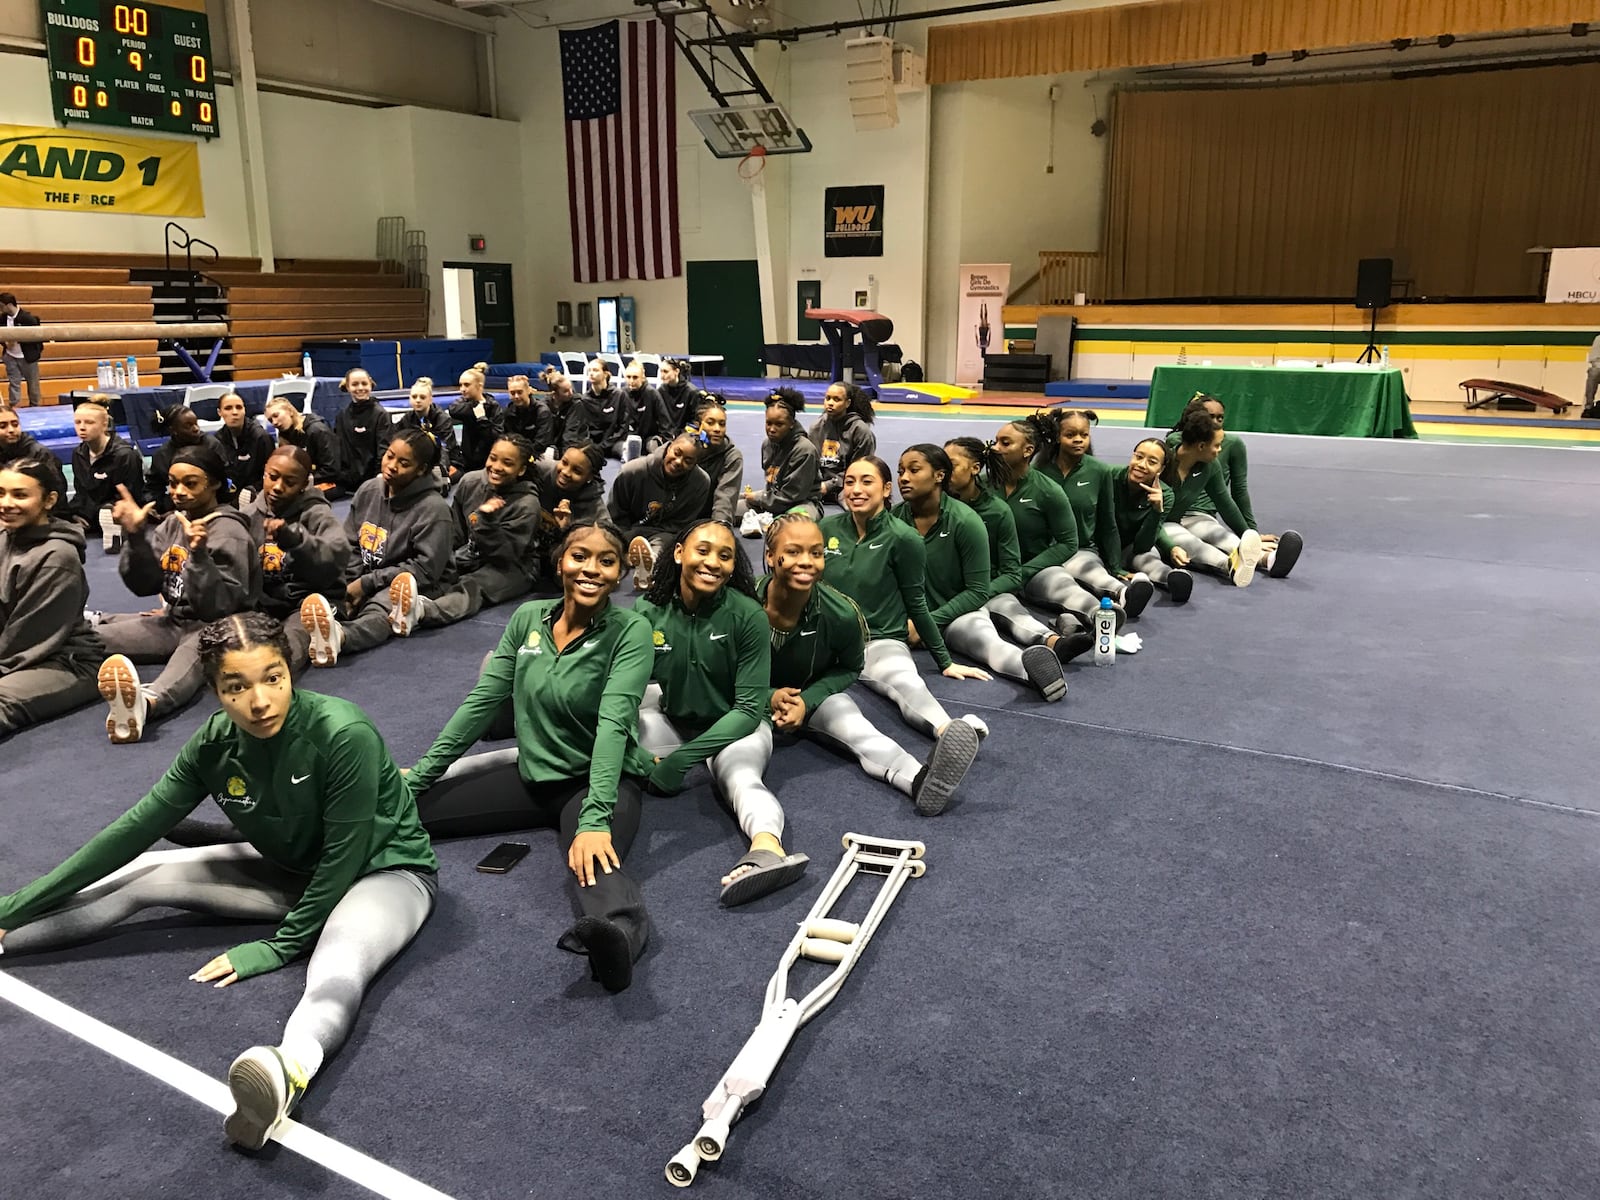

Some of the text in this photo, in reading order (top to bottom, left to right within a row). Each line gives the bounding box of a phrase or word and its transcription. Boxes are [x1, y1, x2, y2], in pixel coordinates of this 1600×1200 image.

[47, 12, 99, 32] BULLDOGS
[122, 38, 146, 50] PERIOD
[174, 34, 201, 49] GUEST
[79, 37, 94, 66] 0
[129, 51, 142, 72] 9
[191, 55, 206, 83] 0
[69, 73, 90, 83] FOULS
[115, 79, 165, 93] PLAYER FOULS
[74, 85, 87, 108] 0
[97, 90, 108, 108] 0
[196, 91, 214, 100] FOULS
[64, 108, 90, 119] POINTS
[172, 101, 181, 116] 0
[200, 102, 212, 123] 0
[131, 116, 154, 126] MATCH
[192, 123, 214, 133] POINTS
[0, 143, 161, 187] AND 1
[45, 192, 70, 204] THE
[832, 205, 876, 224] WU
[1567, 291, 1597, 299] HBCU
[1100, 620, 1111, 654] core
